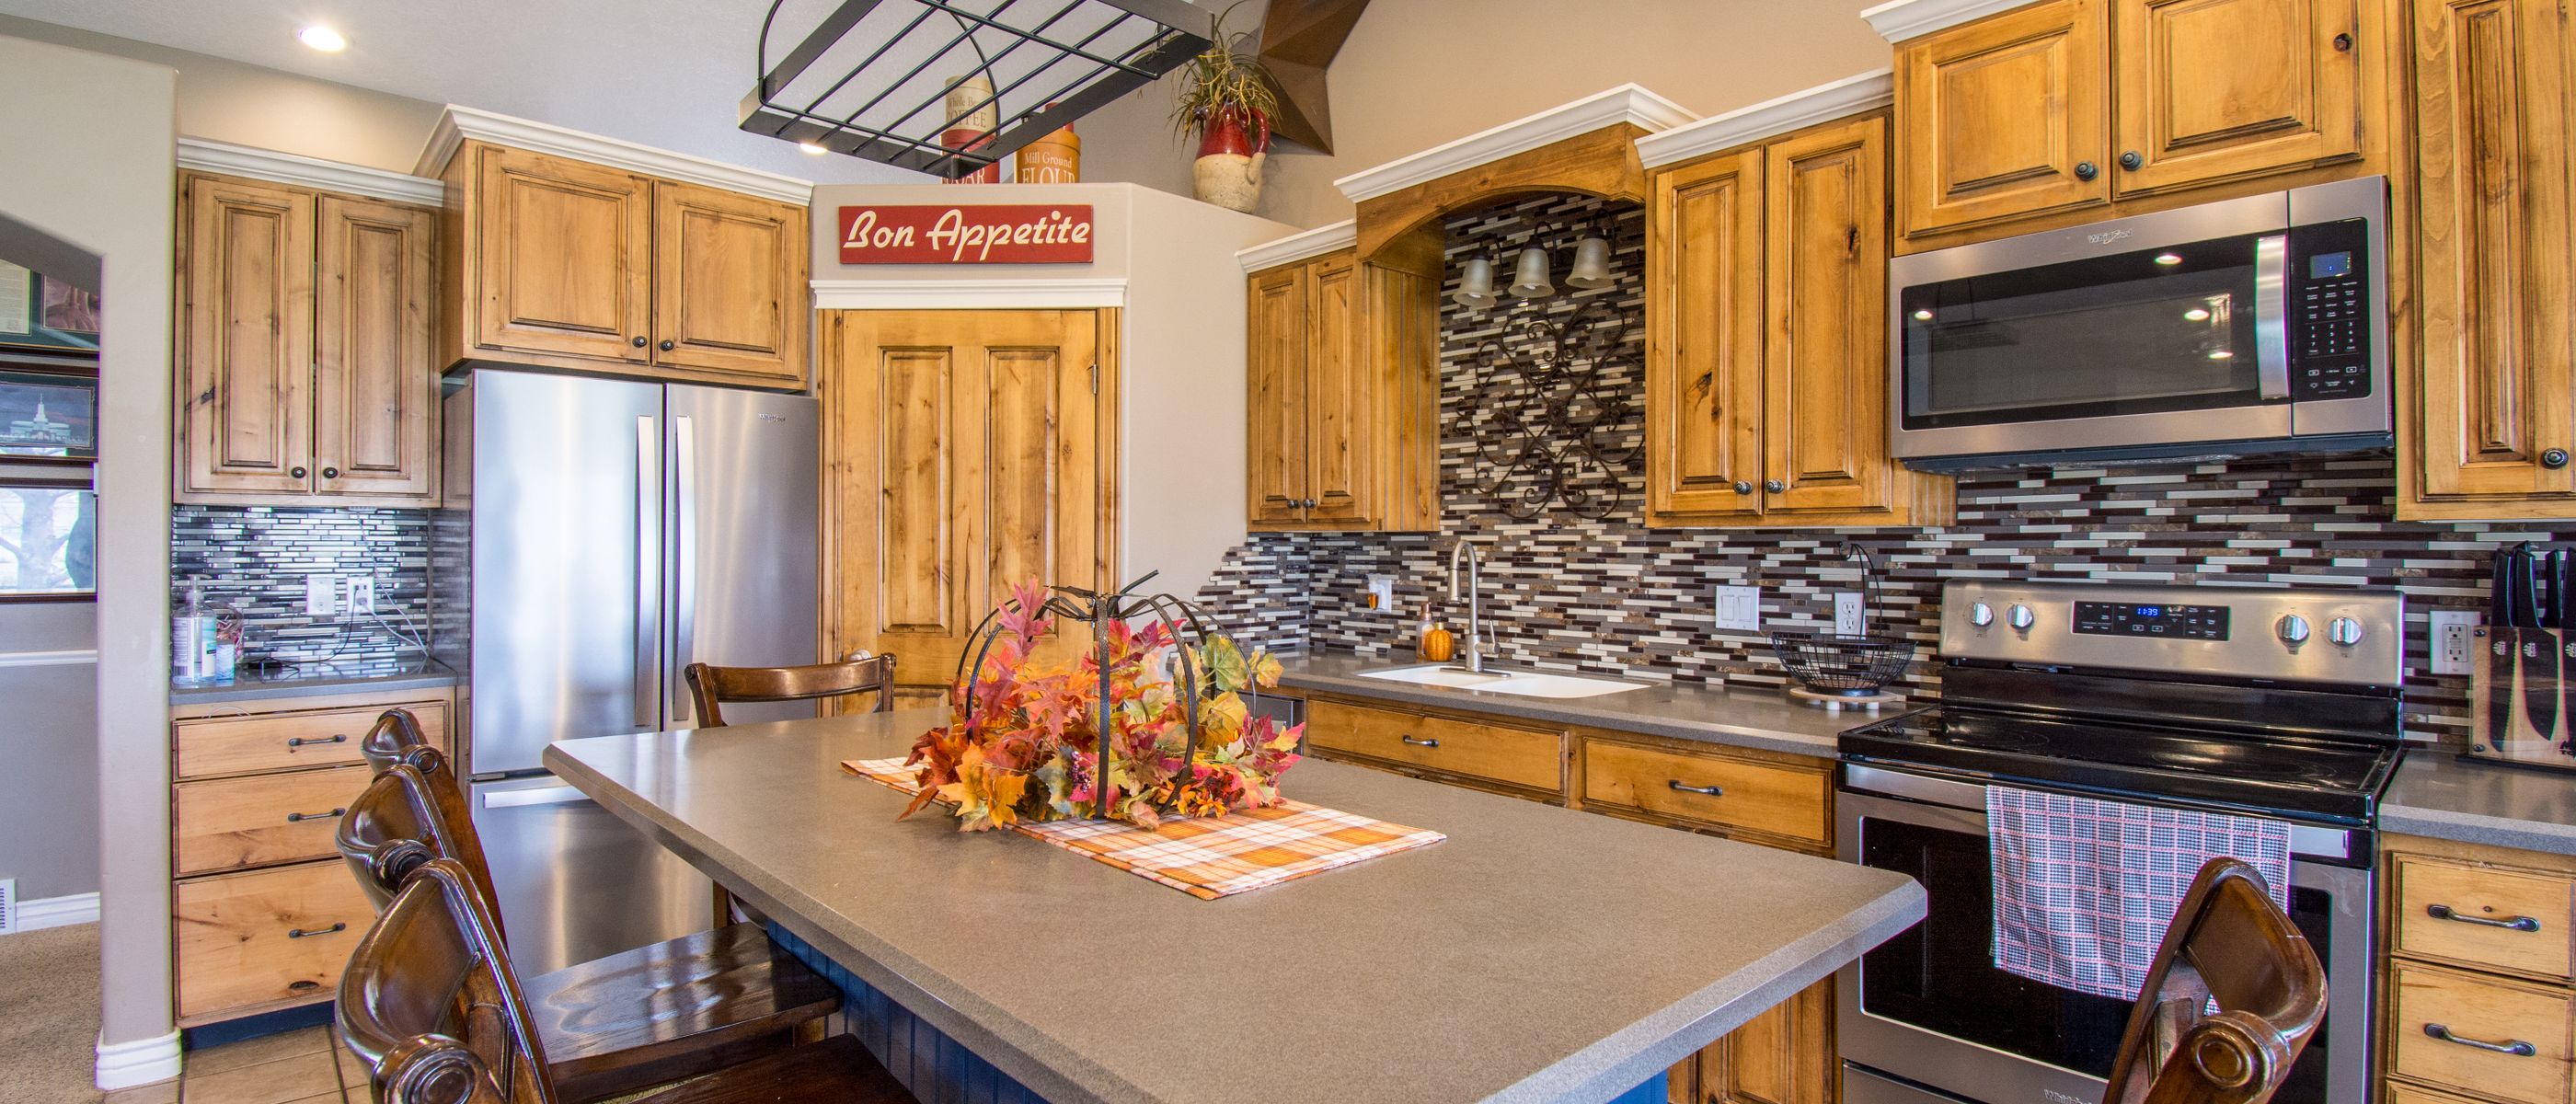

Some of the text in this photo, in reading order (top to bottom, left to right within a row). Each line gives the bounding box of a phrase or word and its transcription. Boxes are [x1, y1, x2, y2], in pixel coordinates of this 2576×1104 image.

[1024, 151, 1073, 168] Mill Ground
[843, 209, 1091, 262] Bon Appetite
[2137, 607, 2158, 616] 11:39
